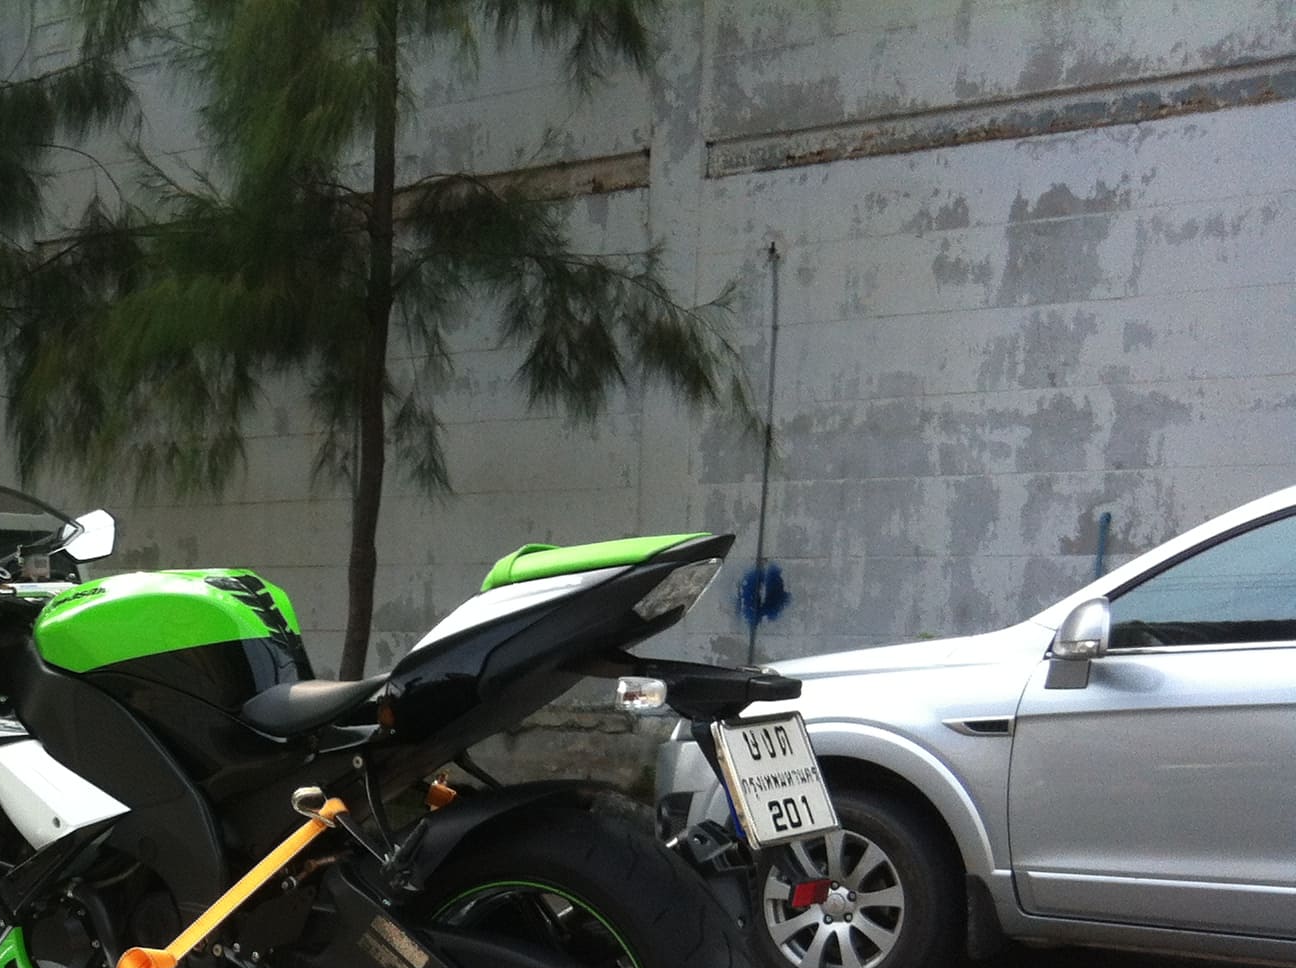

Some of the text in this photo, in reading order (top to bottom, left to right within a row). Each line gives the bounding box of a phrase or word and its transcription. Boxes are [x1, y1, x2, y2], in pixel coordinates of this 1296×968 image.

[741, 766, 820, 800] กรุงเทพมหานคร
[768, 795, 815, 832] 201
